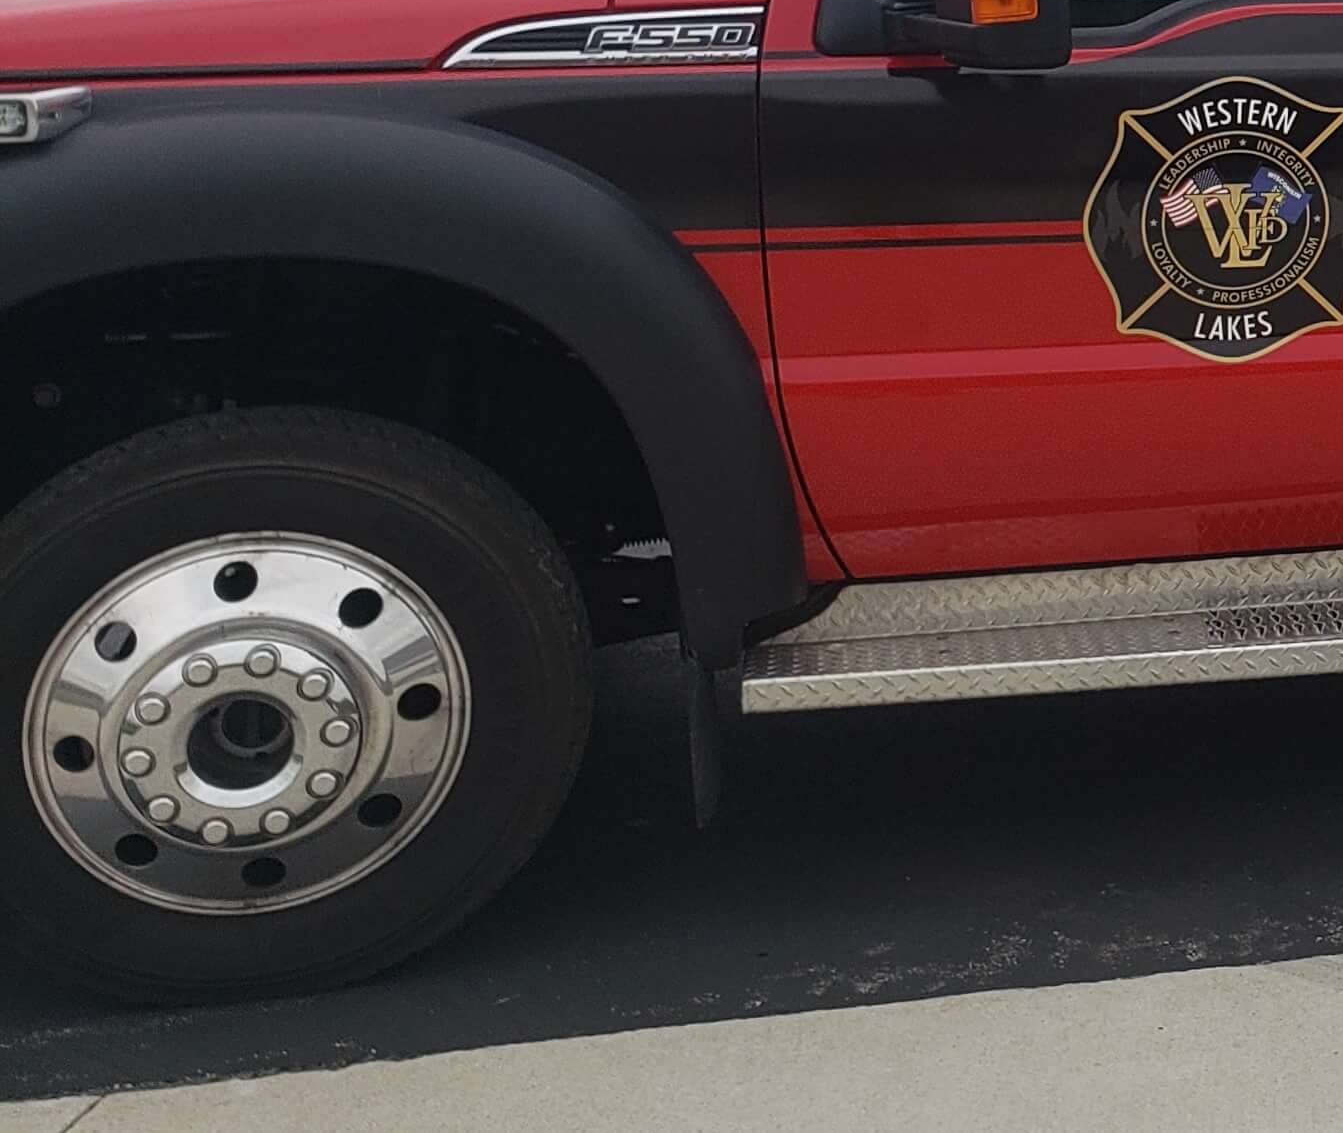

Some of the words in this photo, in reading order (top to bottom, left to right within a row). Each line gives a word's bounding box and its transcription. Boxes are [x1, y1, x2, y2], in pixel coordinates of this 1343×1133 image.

[582, 22, 755, 54] F-550
[1177, 98, 1298, 135] WESTERN
[1159, 138, 1231, 191] LEADERSHIP
[1256, 139, 1316, 188] INTEGRITY
[1152, 242, 1192, 289] LOYALTY
[1212, 236, 1320, 303] PROFESSIONALISM
[1193, 311, 1273, 341] LAKES
